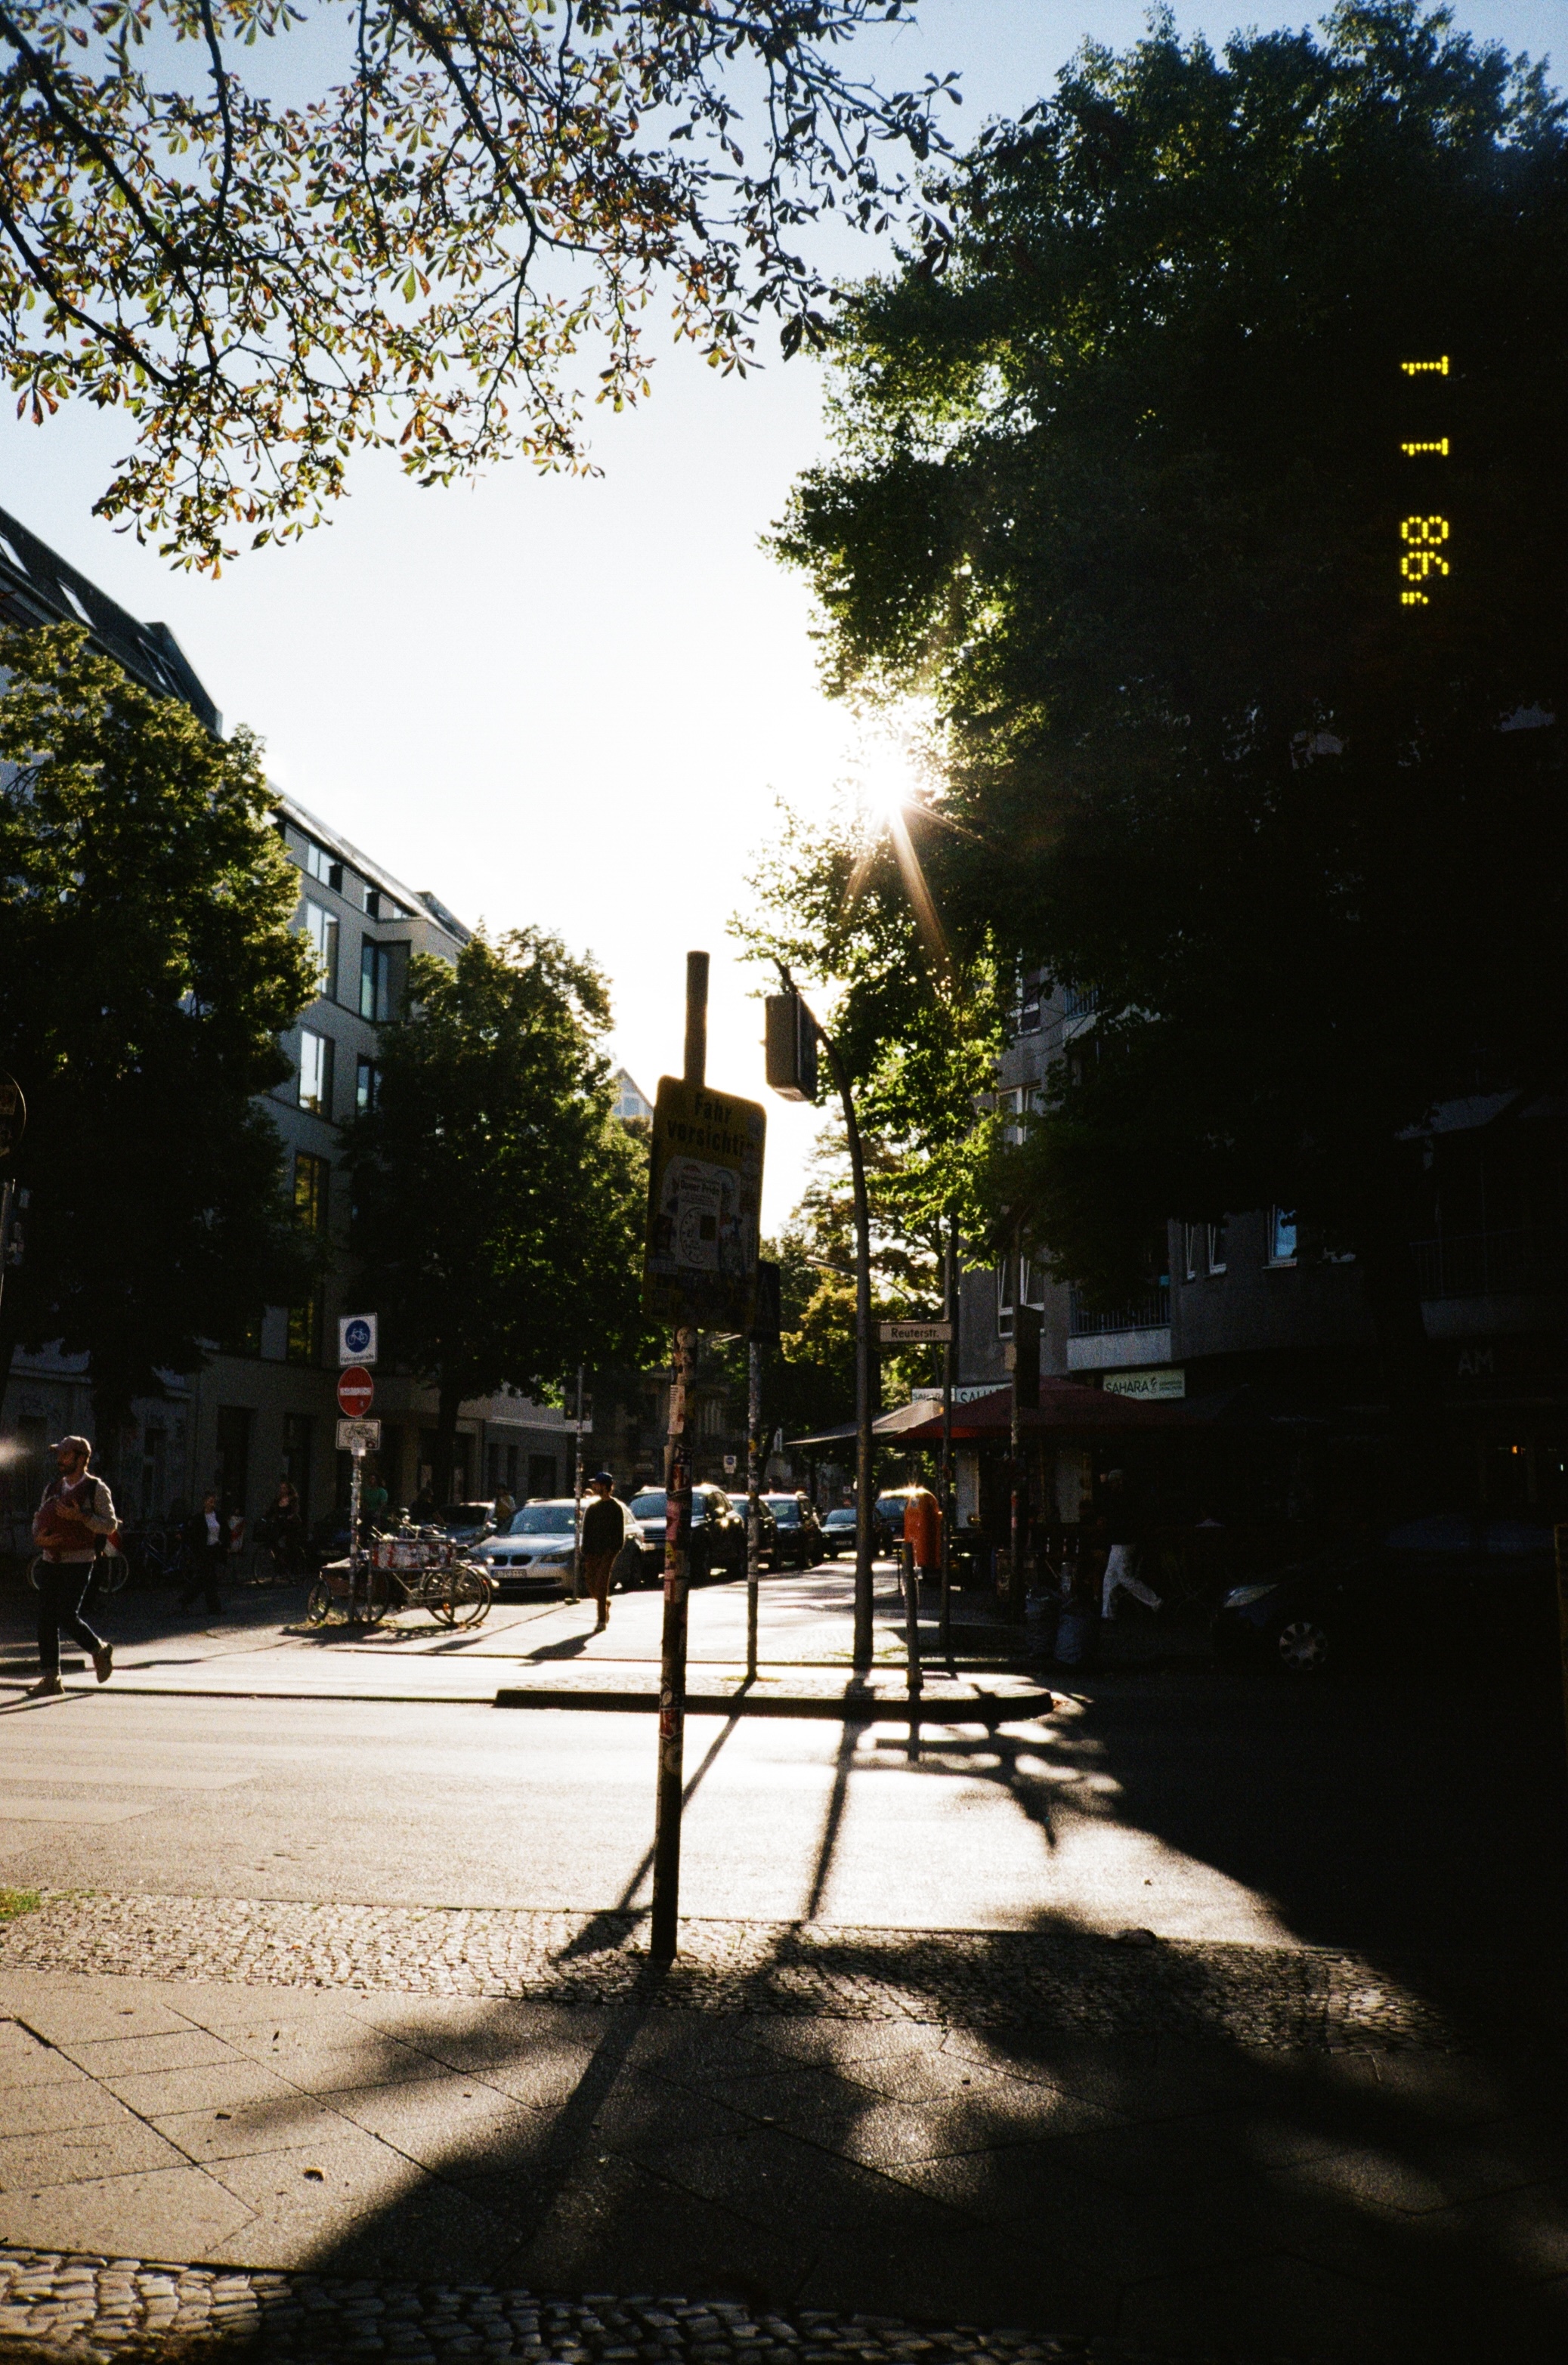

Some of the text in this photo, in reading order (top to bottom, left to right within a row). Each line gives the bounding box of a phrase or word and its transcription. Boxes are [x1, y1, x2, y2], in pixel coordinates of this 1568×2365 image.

[694, 1092, 732, 1124] Fahr
[891, 1328, 940, 1338] Reuterstr.
[1106, 1380, 1149, 1394] SAHARA
